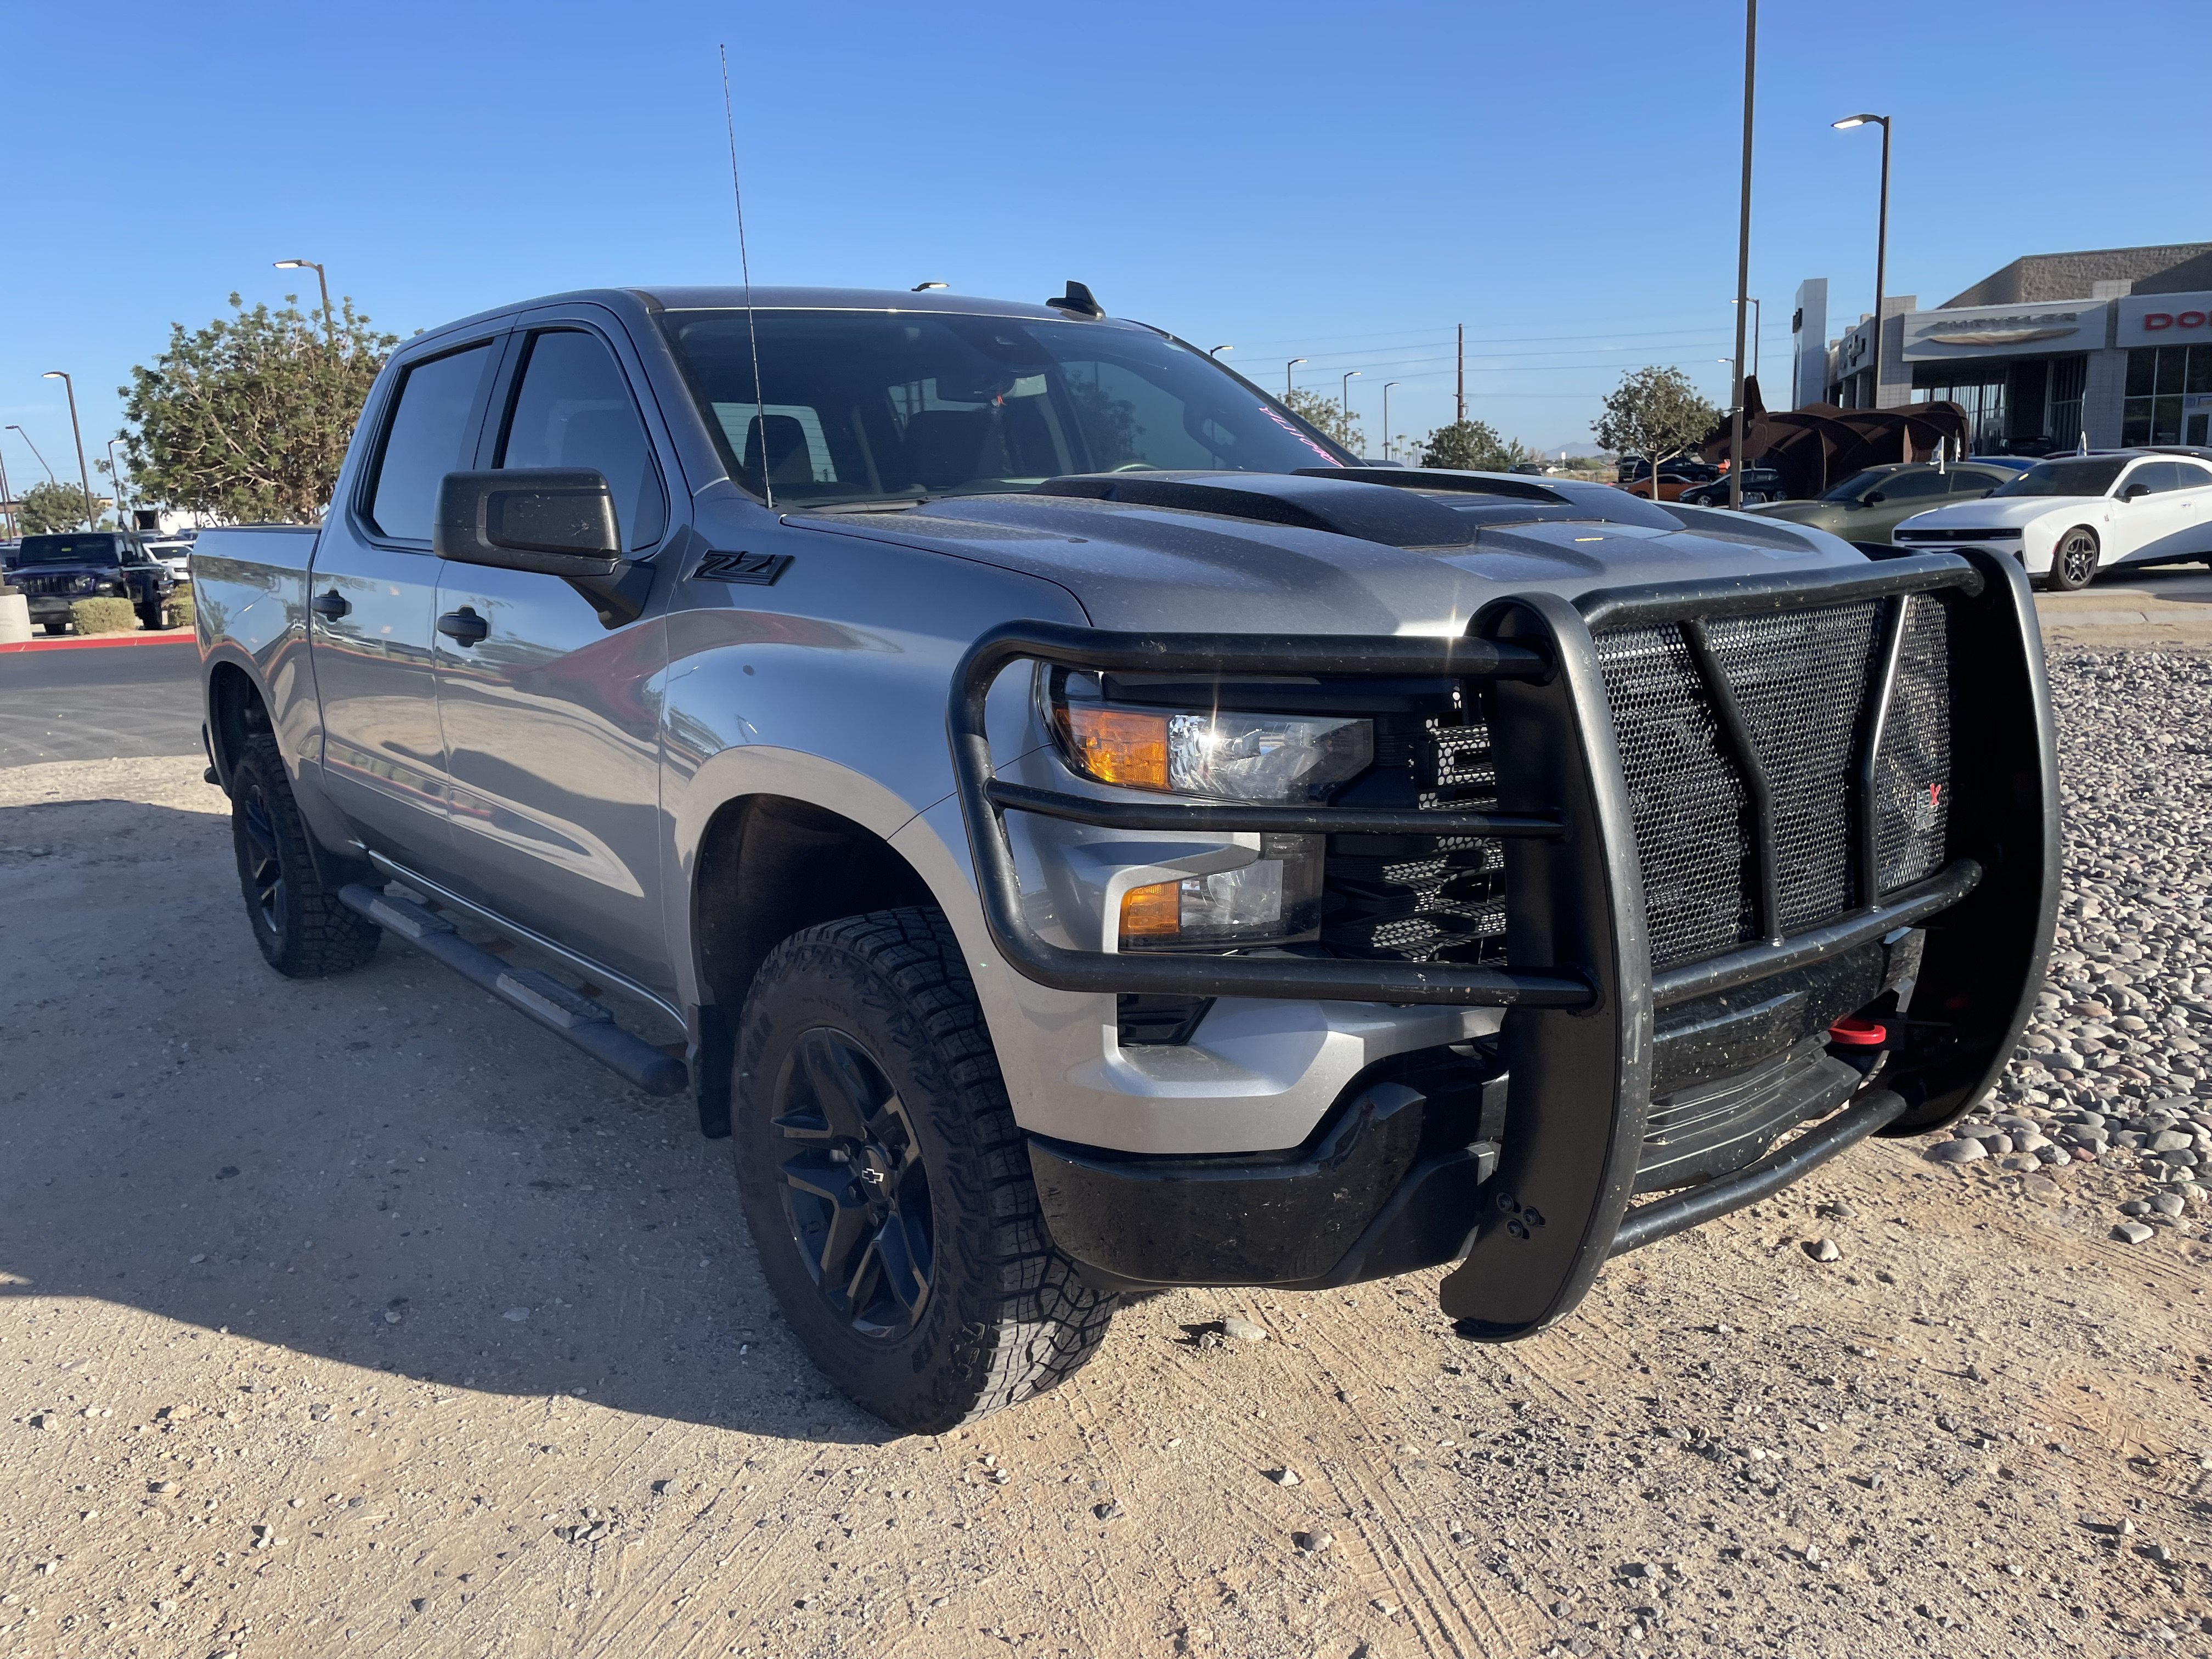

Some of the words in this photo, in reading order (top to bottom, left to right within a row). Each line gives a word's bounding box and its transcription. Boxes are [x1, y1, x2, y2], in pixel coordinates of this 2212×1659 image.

[2144, 311, 2212, 331] DO
[690, 549, 795, 586] Z71
[1916, 783, 1941, 809] HDX
